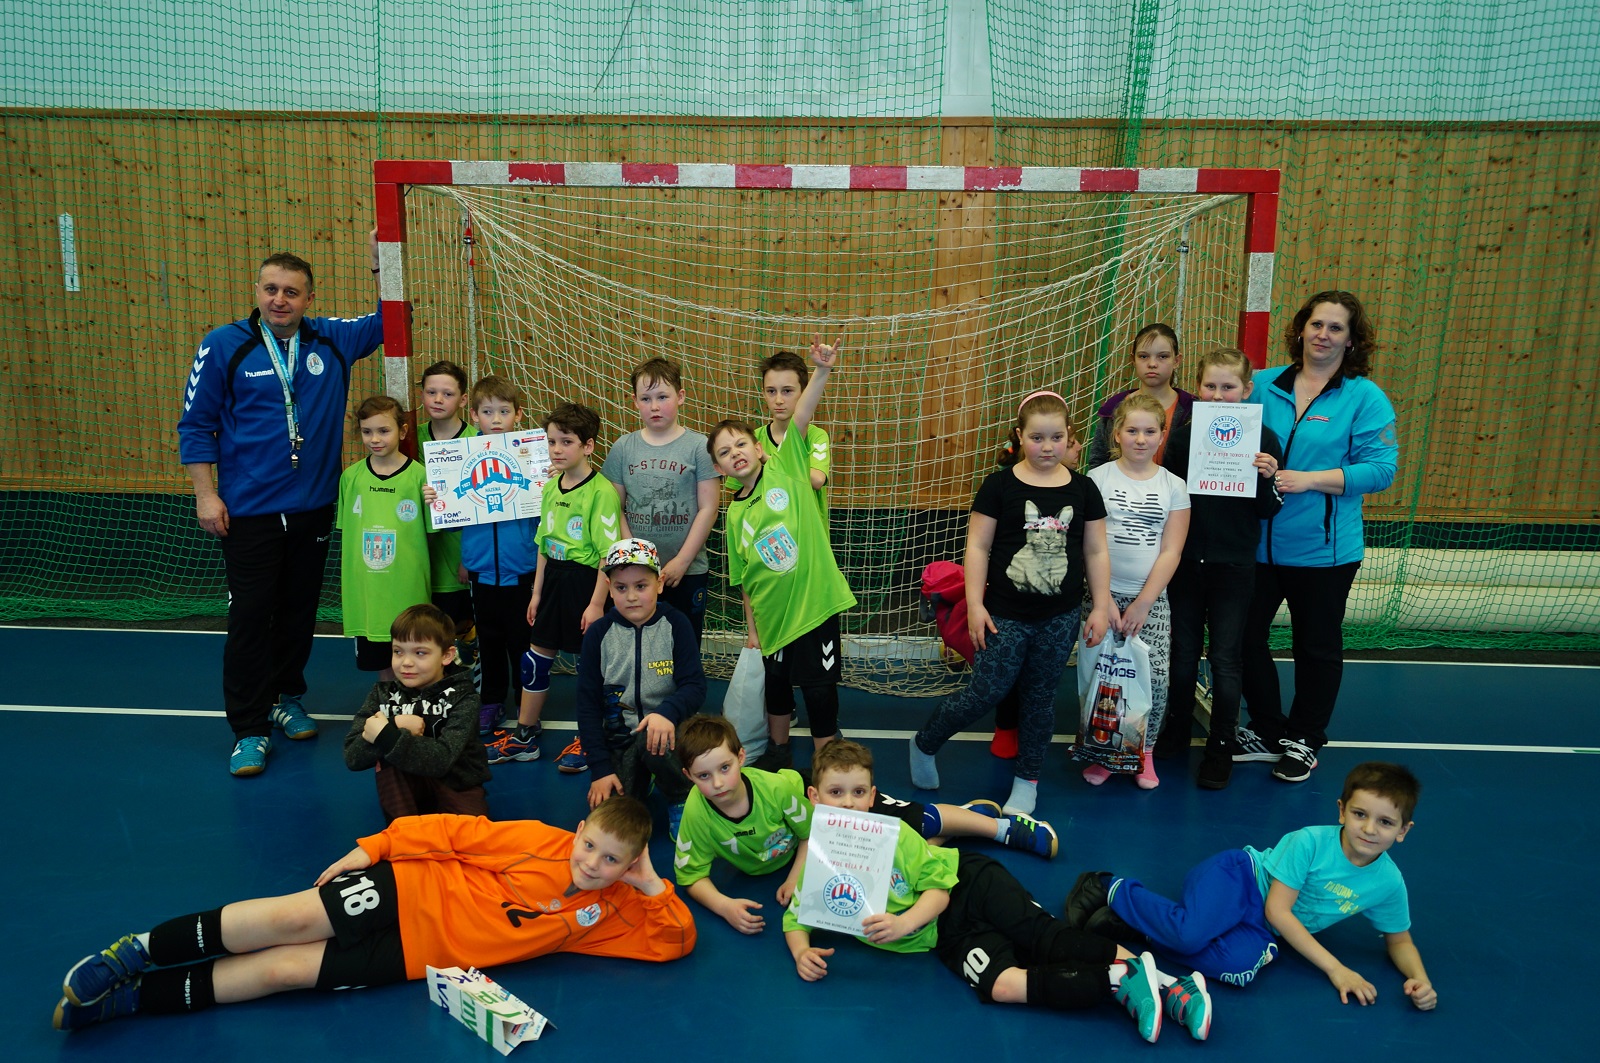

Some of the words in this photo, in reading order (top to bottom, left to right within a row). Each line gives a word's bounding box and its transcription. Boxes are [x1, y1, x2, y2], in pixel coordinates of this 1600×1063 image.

[245, 369, 274, 377] hummel
[428, 455, 463, 463] ATMOS
[628, 459, 687, 475] G-STORY
[1200, 480, 1244, 492] DIPLOM
[352, 494, 362, 518] 4
[488, 495, 501, 505] 90
[547, 510, 554, 534] 6
[1095, 662, 1136, 678] ATMOS
[379, 702, 416, 718] NEW
[733, 827, 756, 837] ummel
[827, 813, 883, 835] DIPLOM
[340, 876, 380, 916] 18
[963, 947, 990, 984] 10
